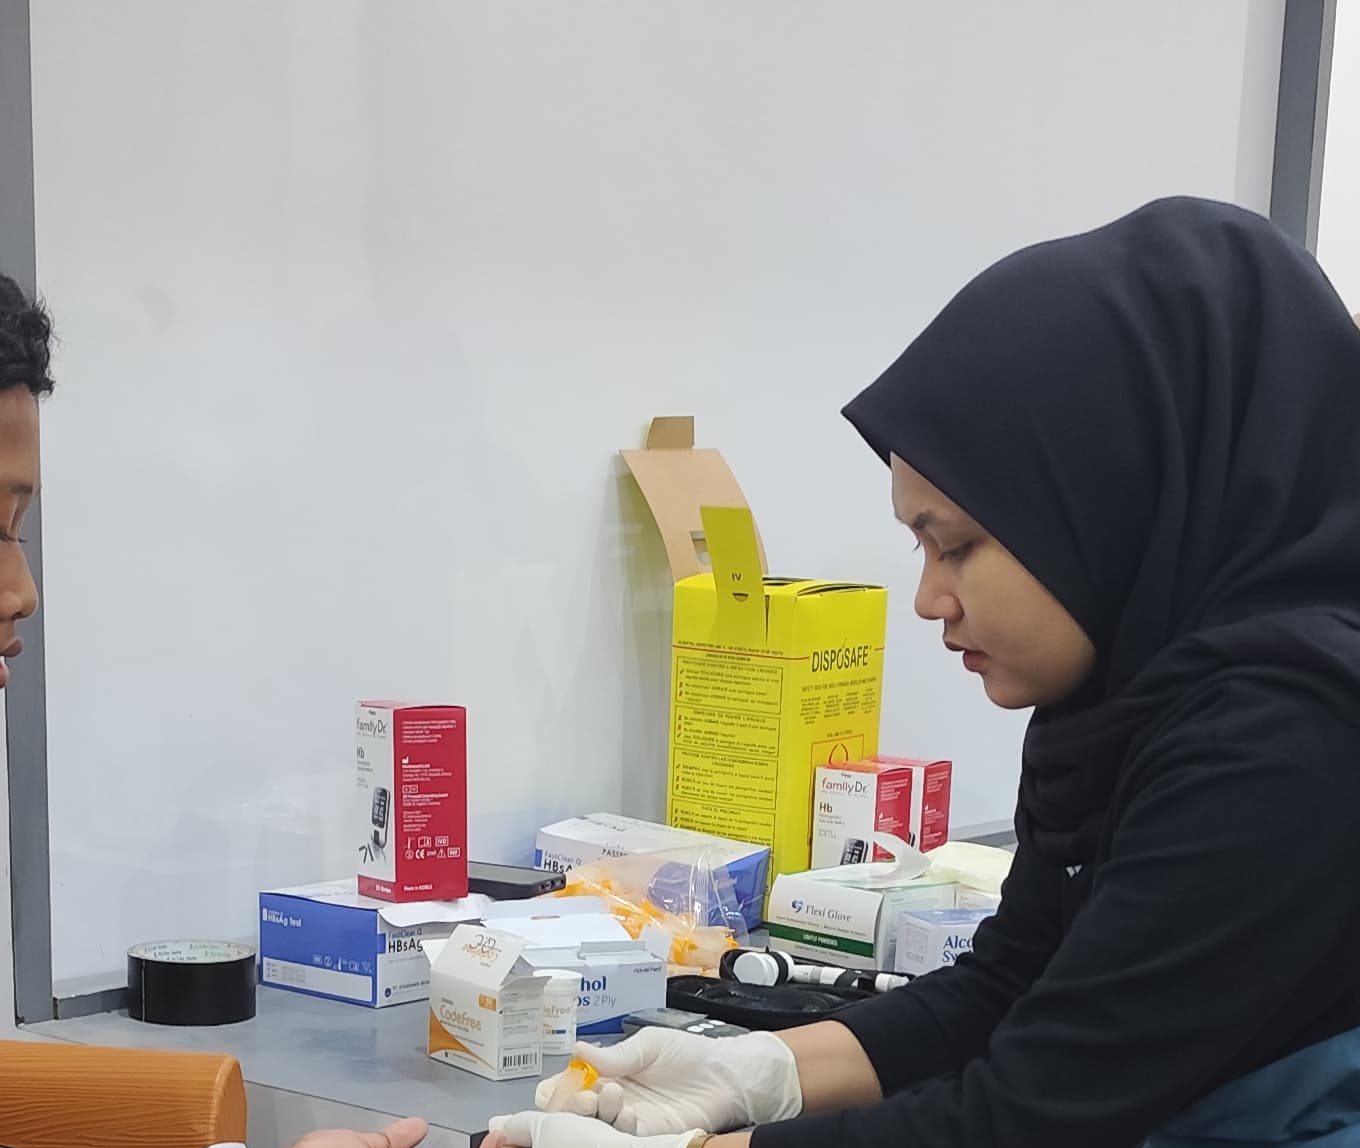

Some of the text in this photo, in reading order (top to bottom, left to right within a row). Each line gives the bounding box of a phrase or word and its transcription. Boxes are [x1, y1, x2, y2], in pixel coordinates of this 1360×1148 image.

[731, 573, 741, 581] IV
[812, 645, 869, 673] DISPOSAFE
[356, 746, 365, 759] Hb
[819, 802, 833, 813] Hb
[543, 858, 573, 873] HBsA
[544, 851, 582, 866] FastClear Q
[267, 912, 288, 927] HBsAg
[289, 917, 302, 927] Test
[805, 904, 852, 922] Flexi Glove
[417, 927, 423, 936] Q
[943, 935, 974, 949] Alco
[942, 950, 959, 963] Sw
[580, 975, 607, 992] hol
[601, 993, 617, 1008] Ply
[440, 1004, 482, 1031] CodeFree
